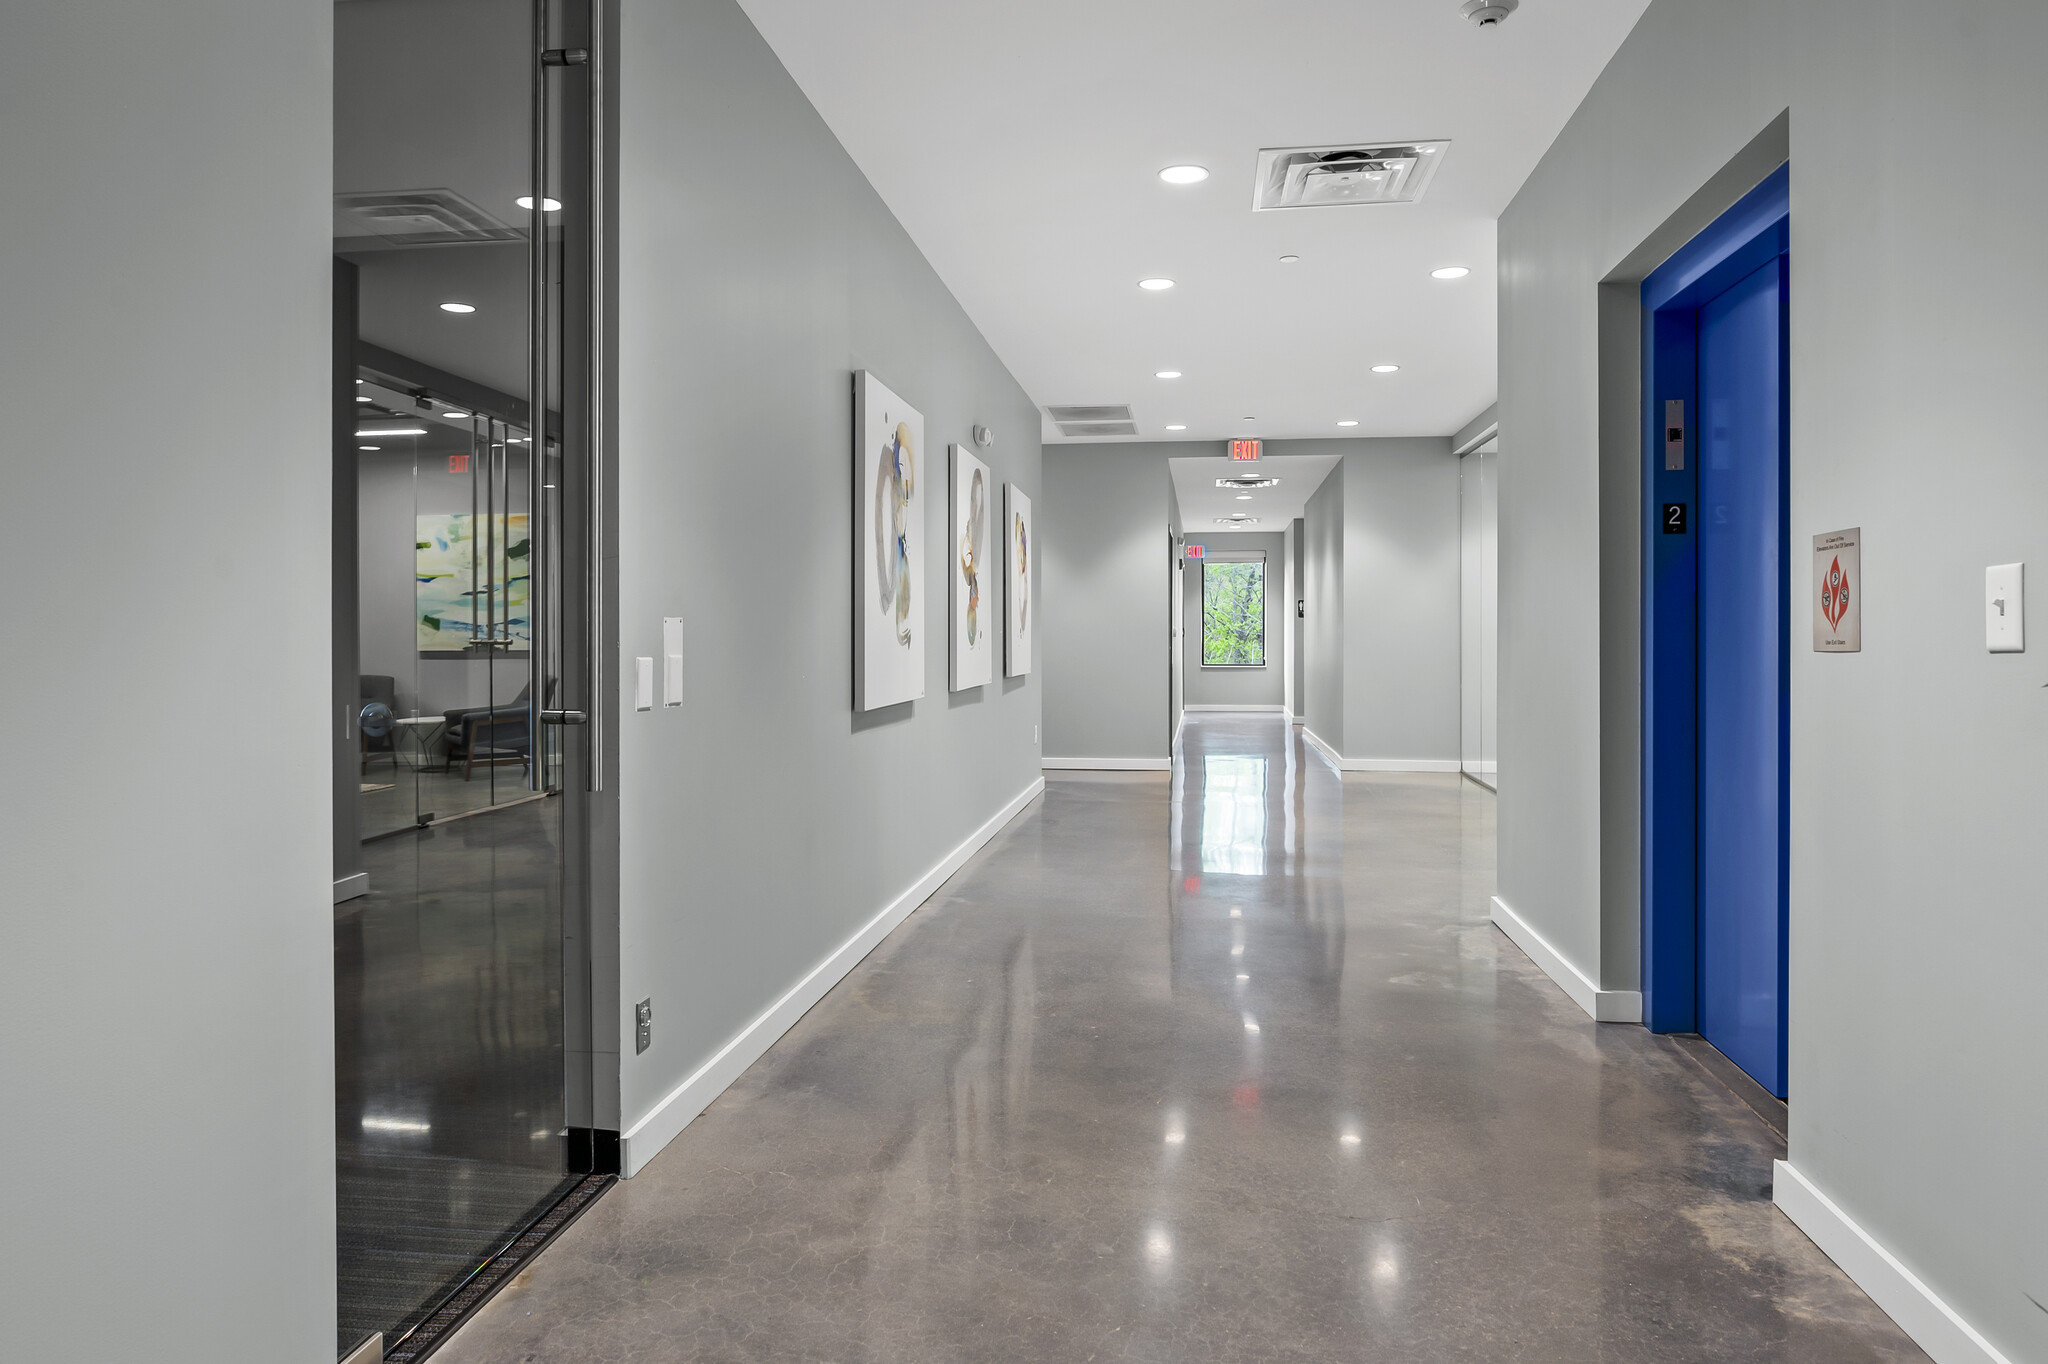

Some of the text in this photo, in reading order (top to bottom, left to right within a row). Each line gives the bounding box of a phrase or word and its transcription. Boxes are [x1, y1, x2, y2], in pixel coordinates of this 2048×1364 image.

[1232, 440, 1259, 460] EXIT
[449, 455, 470, 473] EXIT
[1668, 505, 1681, 525] 2
[1187, 545, 1203, 557] EXIT
